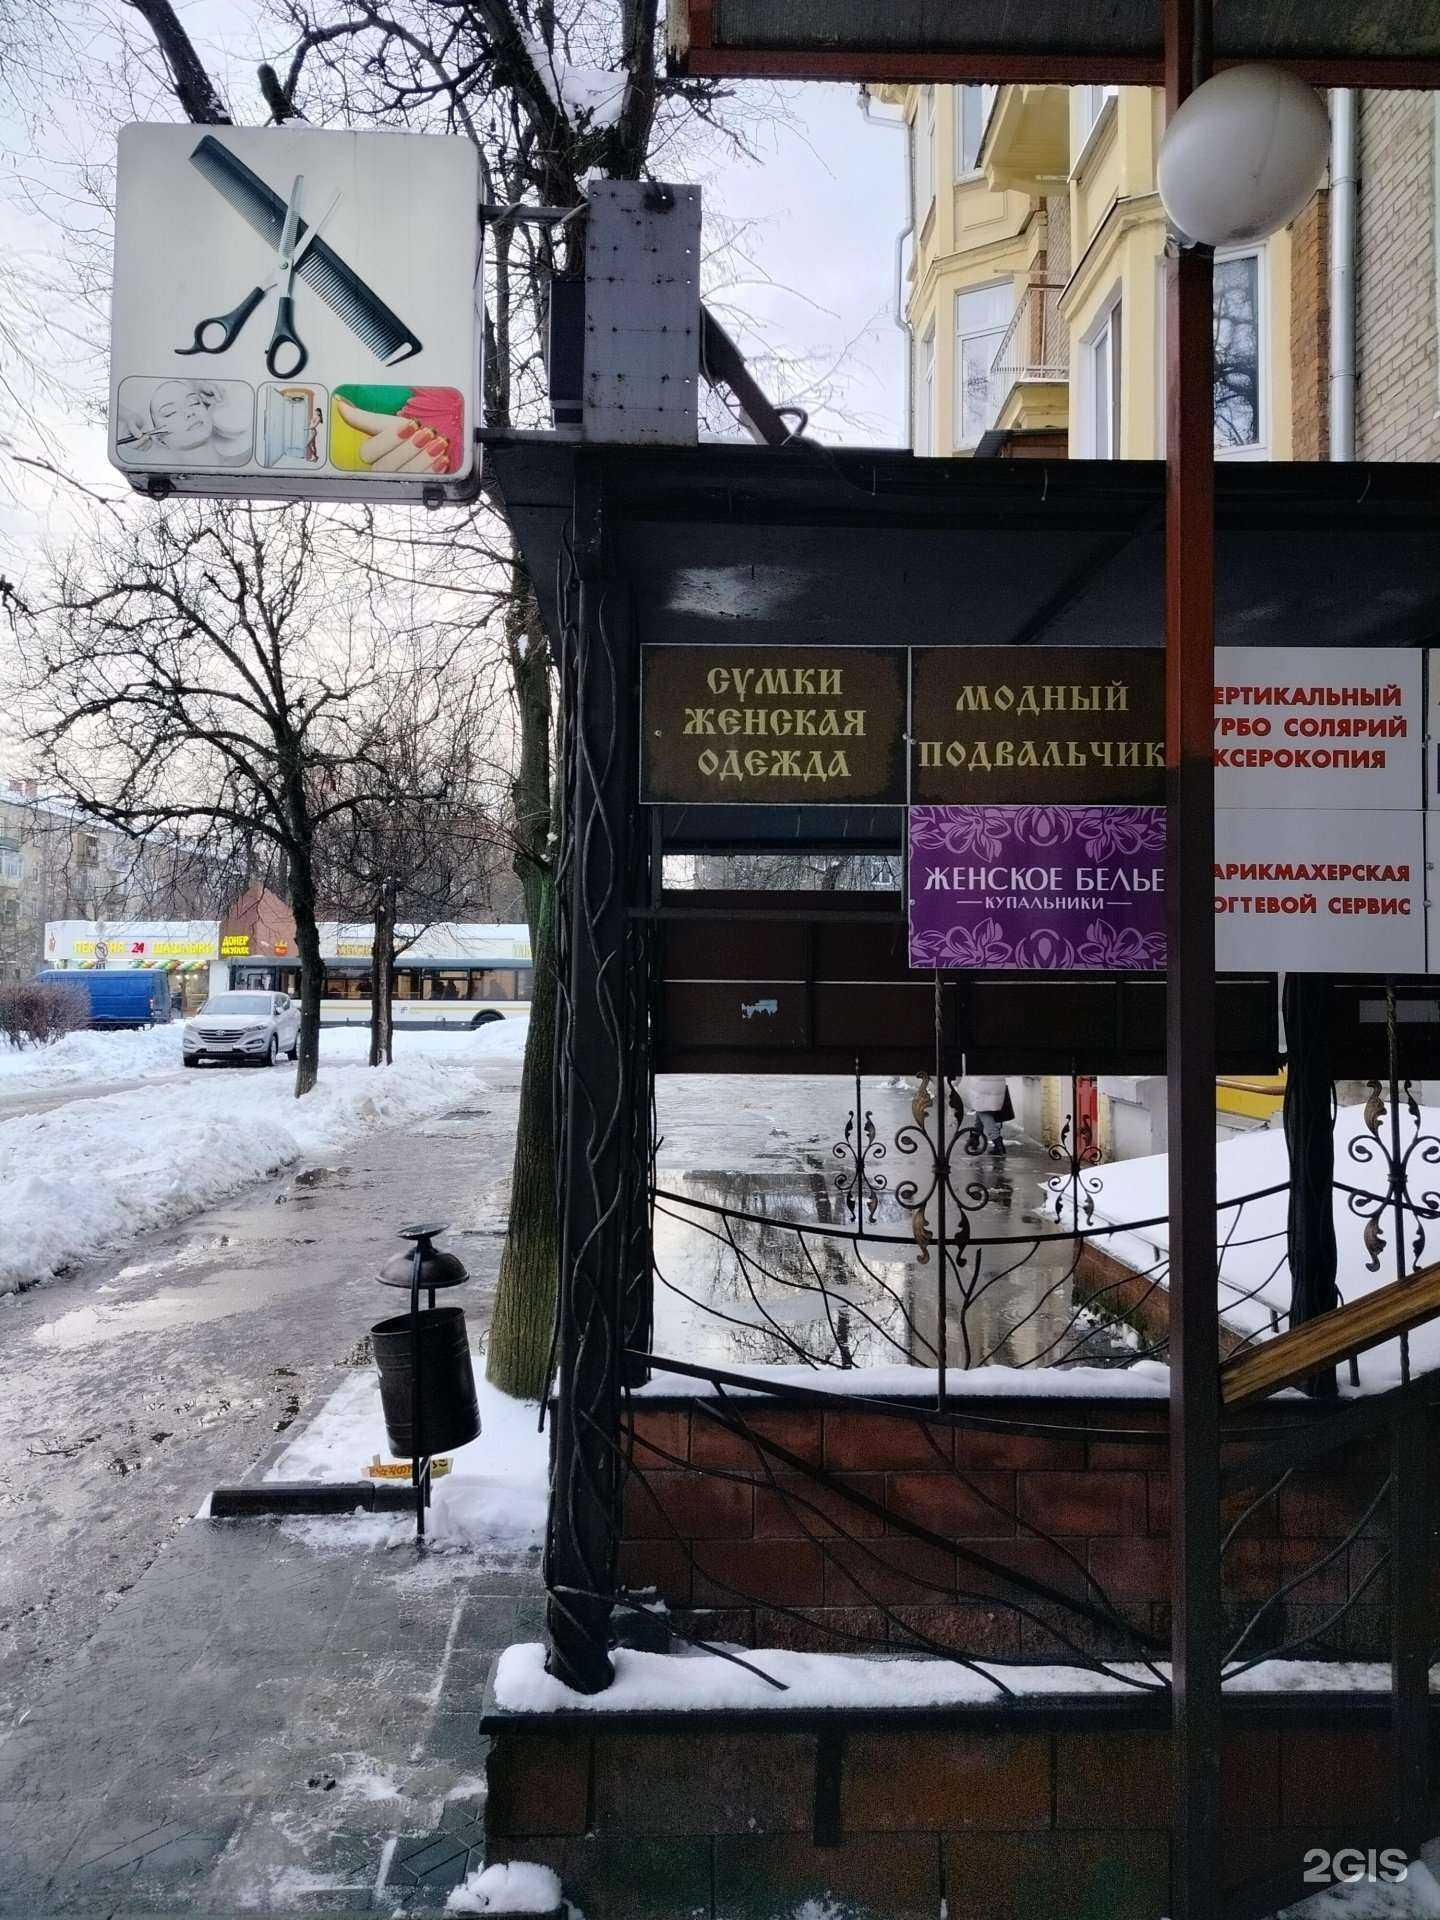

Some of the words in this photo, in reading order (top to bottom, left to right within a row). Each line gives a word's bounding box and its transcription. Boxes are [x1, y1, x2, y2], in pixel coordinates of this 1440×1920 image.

[706, 667, 844, 702] СУМКИ
[1213, 684, 1402, 706] ЕРТИКАЛЬНЫЙ
[956, 680, 1129, 717] МОДНЫЙ
[682, 708, 867, 736] ЖЕНСКАЯ
[1283, 715, 1408, 738] СОЛЯРИЙ
[698, 748, 852, 782] ОДЕЖДА
[918, 740, 1167, 772] ПОДВАЛЬЧИК
[923, 866, 1064, 891] ЖЕНСКОЕ
[1075, 868, 1166, 892] БЕЛЬЕ
[1213, 863, 1410, 882] АРИКМАХЕРСКАЯ
[985, 896, 1105, 910] КУПАЛЬНИКИ
[1213, 893, 1317, 914] ОГТЕВОЙ
[1327, 897, 1412, 915] СЕРВИС
[131, 942, 145, 954] 24
[222, 935, 250, 946] ДОНЕР
